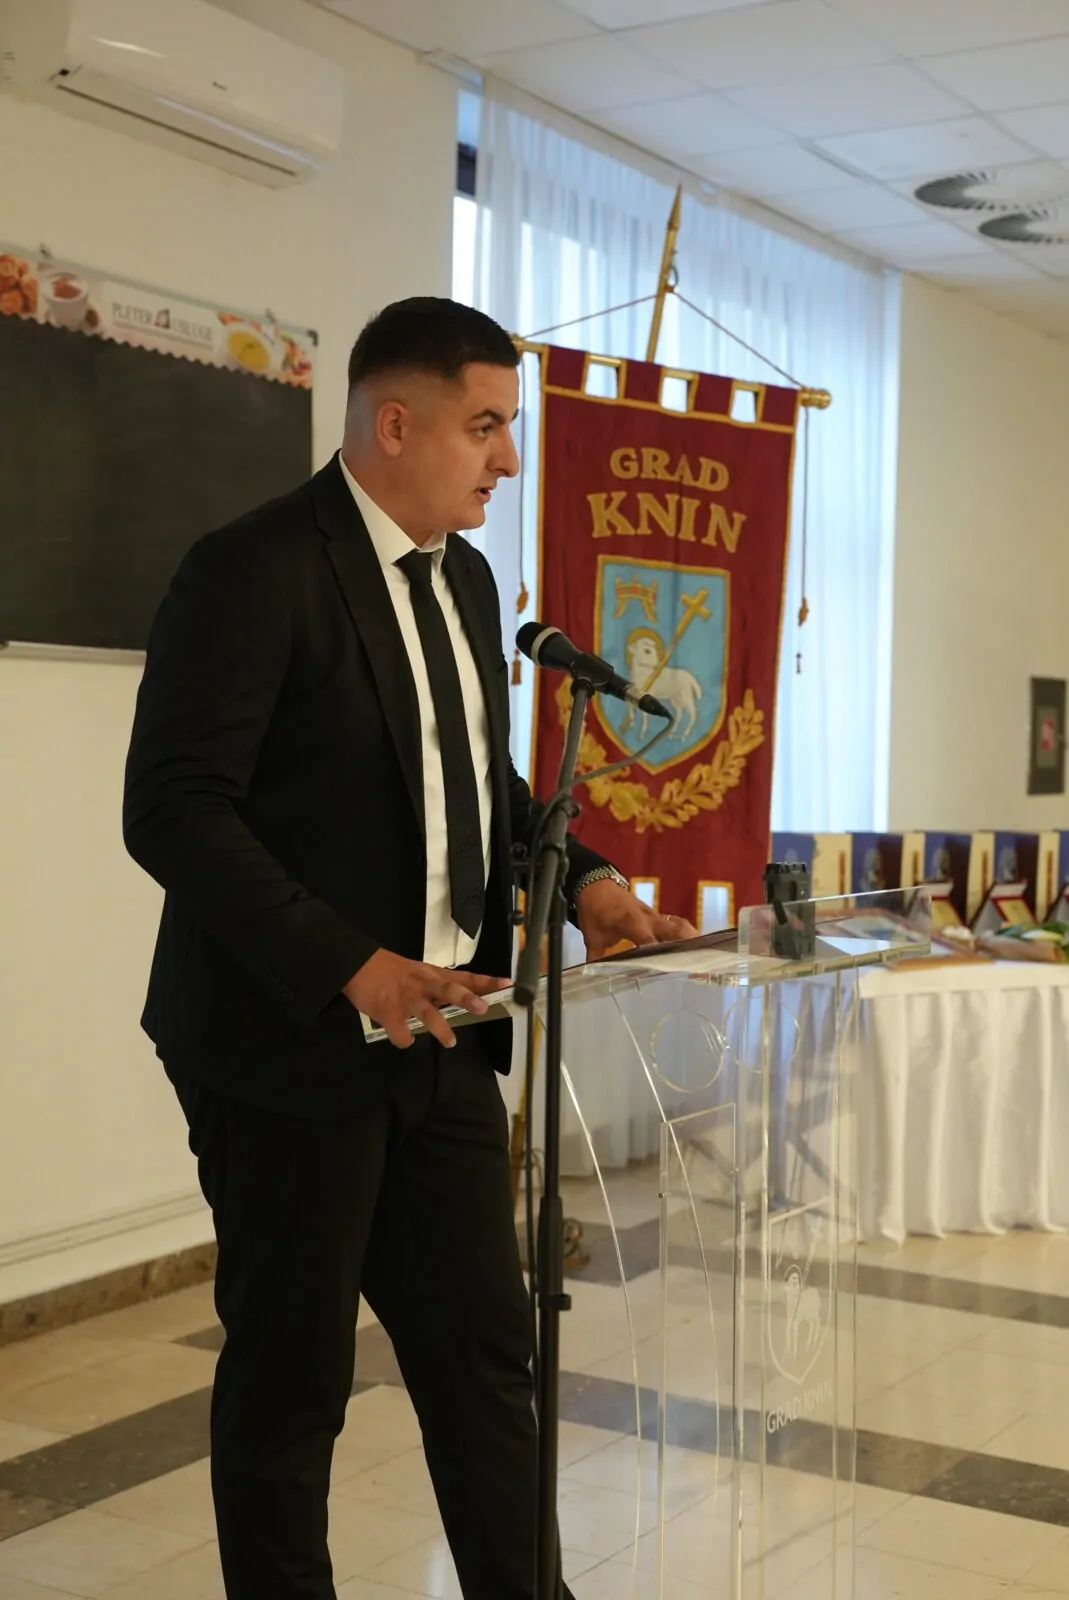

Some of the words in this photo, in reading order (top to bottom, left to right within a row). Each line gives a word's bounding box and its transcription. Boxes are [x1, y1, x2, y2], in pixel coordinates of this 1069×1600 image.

[111, 301, 153, 324] PLETER
[610, 447, 730, 492] GRAD
[587, 491, 747, 553] KNIN
[767, 1397, 802, 1434] GRAD
